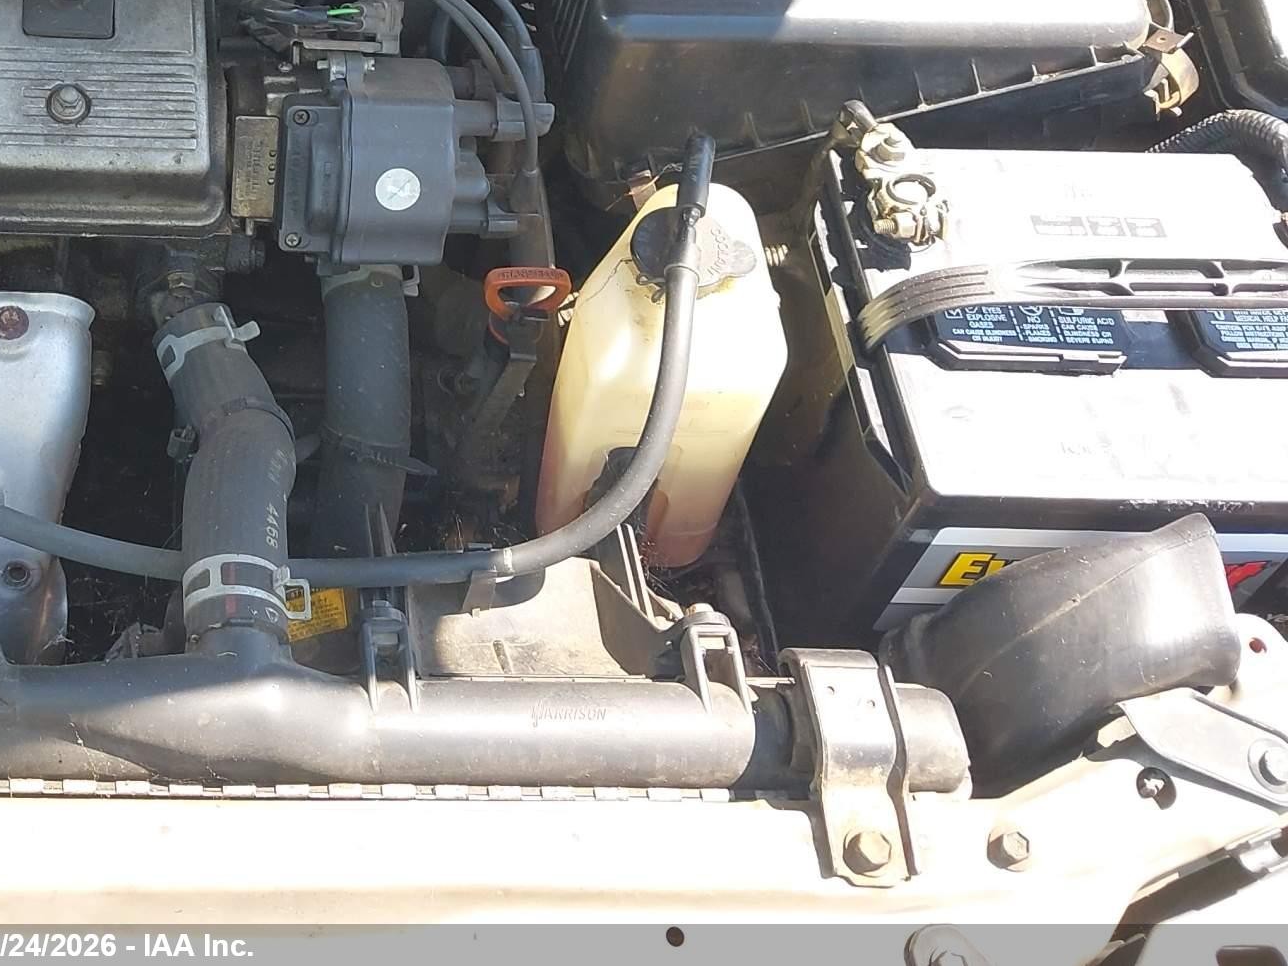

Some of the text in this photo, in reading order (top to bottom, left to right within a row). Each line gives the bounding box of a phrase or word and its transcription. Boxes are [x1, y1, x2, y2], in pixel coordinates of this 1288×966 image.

[982, 306, 1002, 315] EYES
[966, 314, 1008, 322] EXPLOSIVE
[1027, 316, 1041, 324] NO
[1058, 315, 1115, 326] SULFURIC ACID
